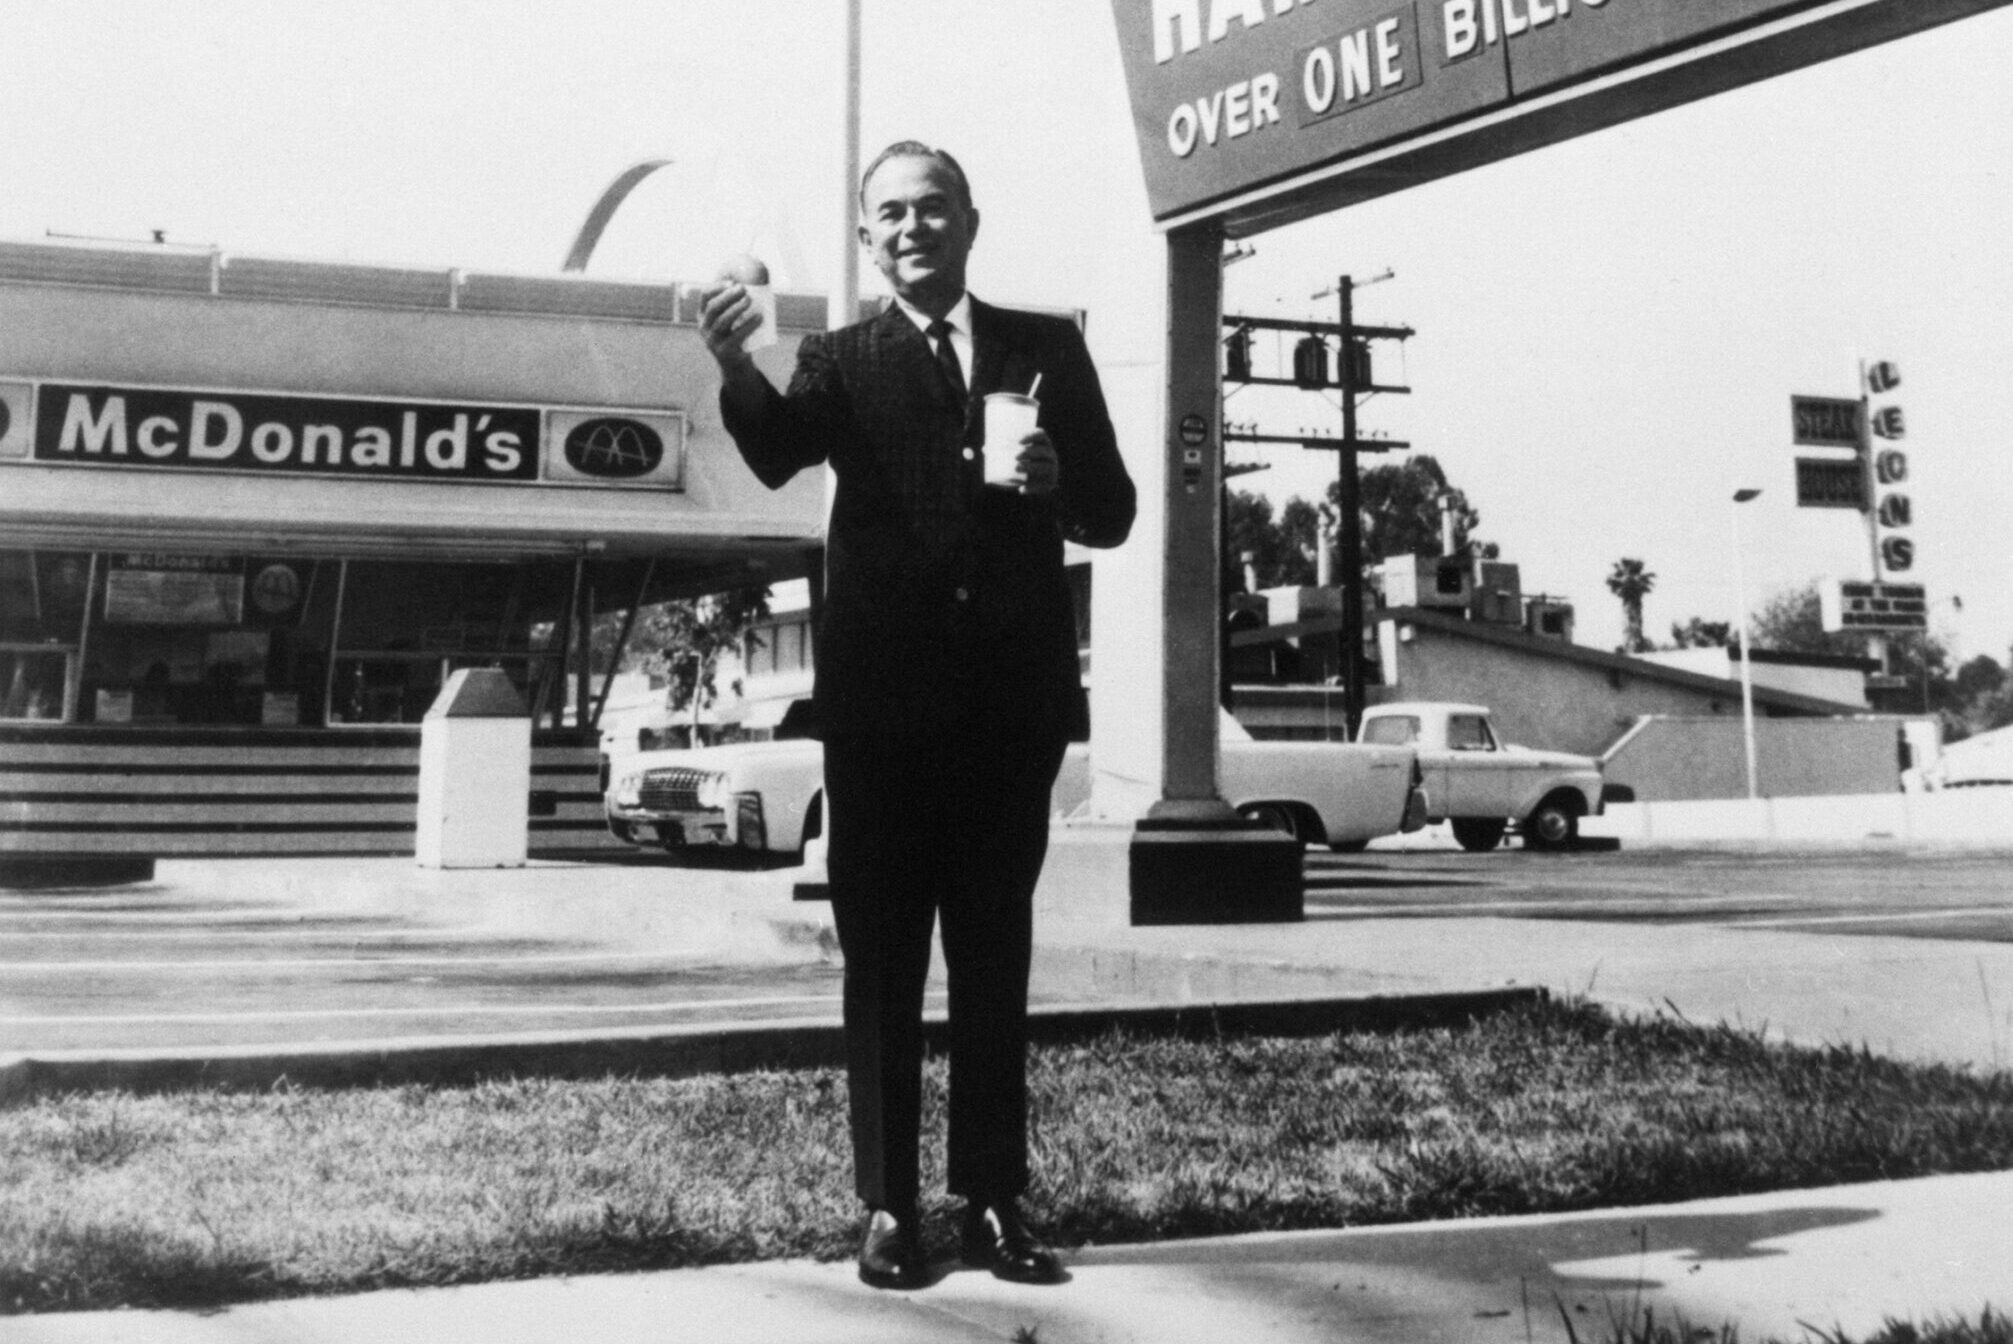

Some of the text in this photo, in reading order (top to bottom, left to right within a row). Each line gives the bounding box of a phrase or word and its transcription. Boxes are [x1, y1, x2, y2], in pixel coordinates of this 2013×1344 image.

[1167, 72, 1281, 157] OVER
[1303, 18, 1403, 113] ONE
[58, 393, 521, 471] McDonald's
[1869, 361, 1914, 572] LEONS
